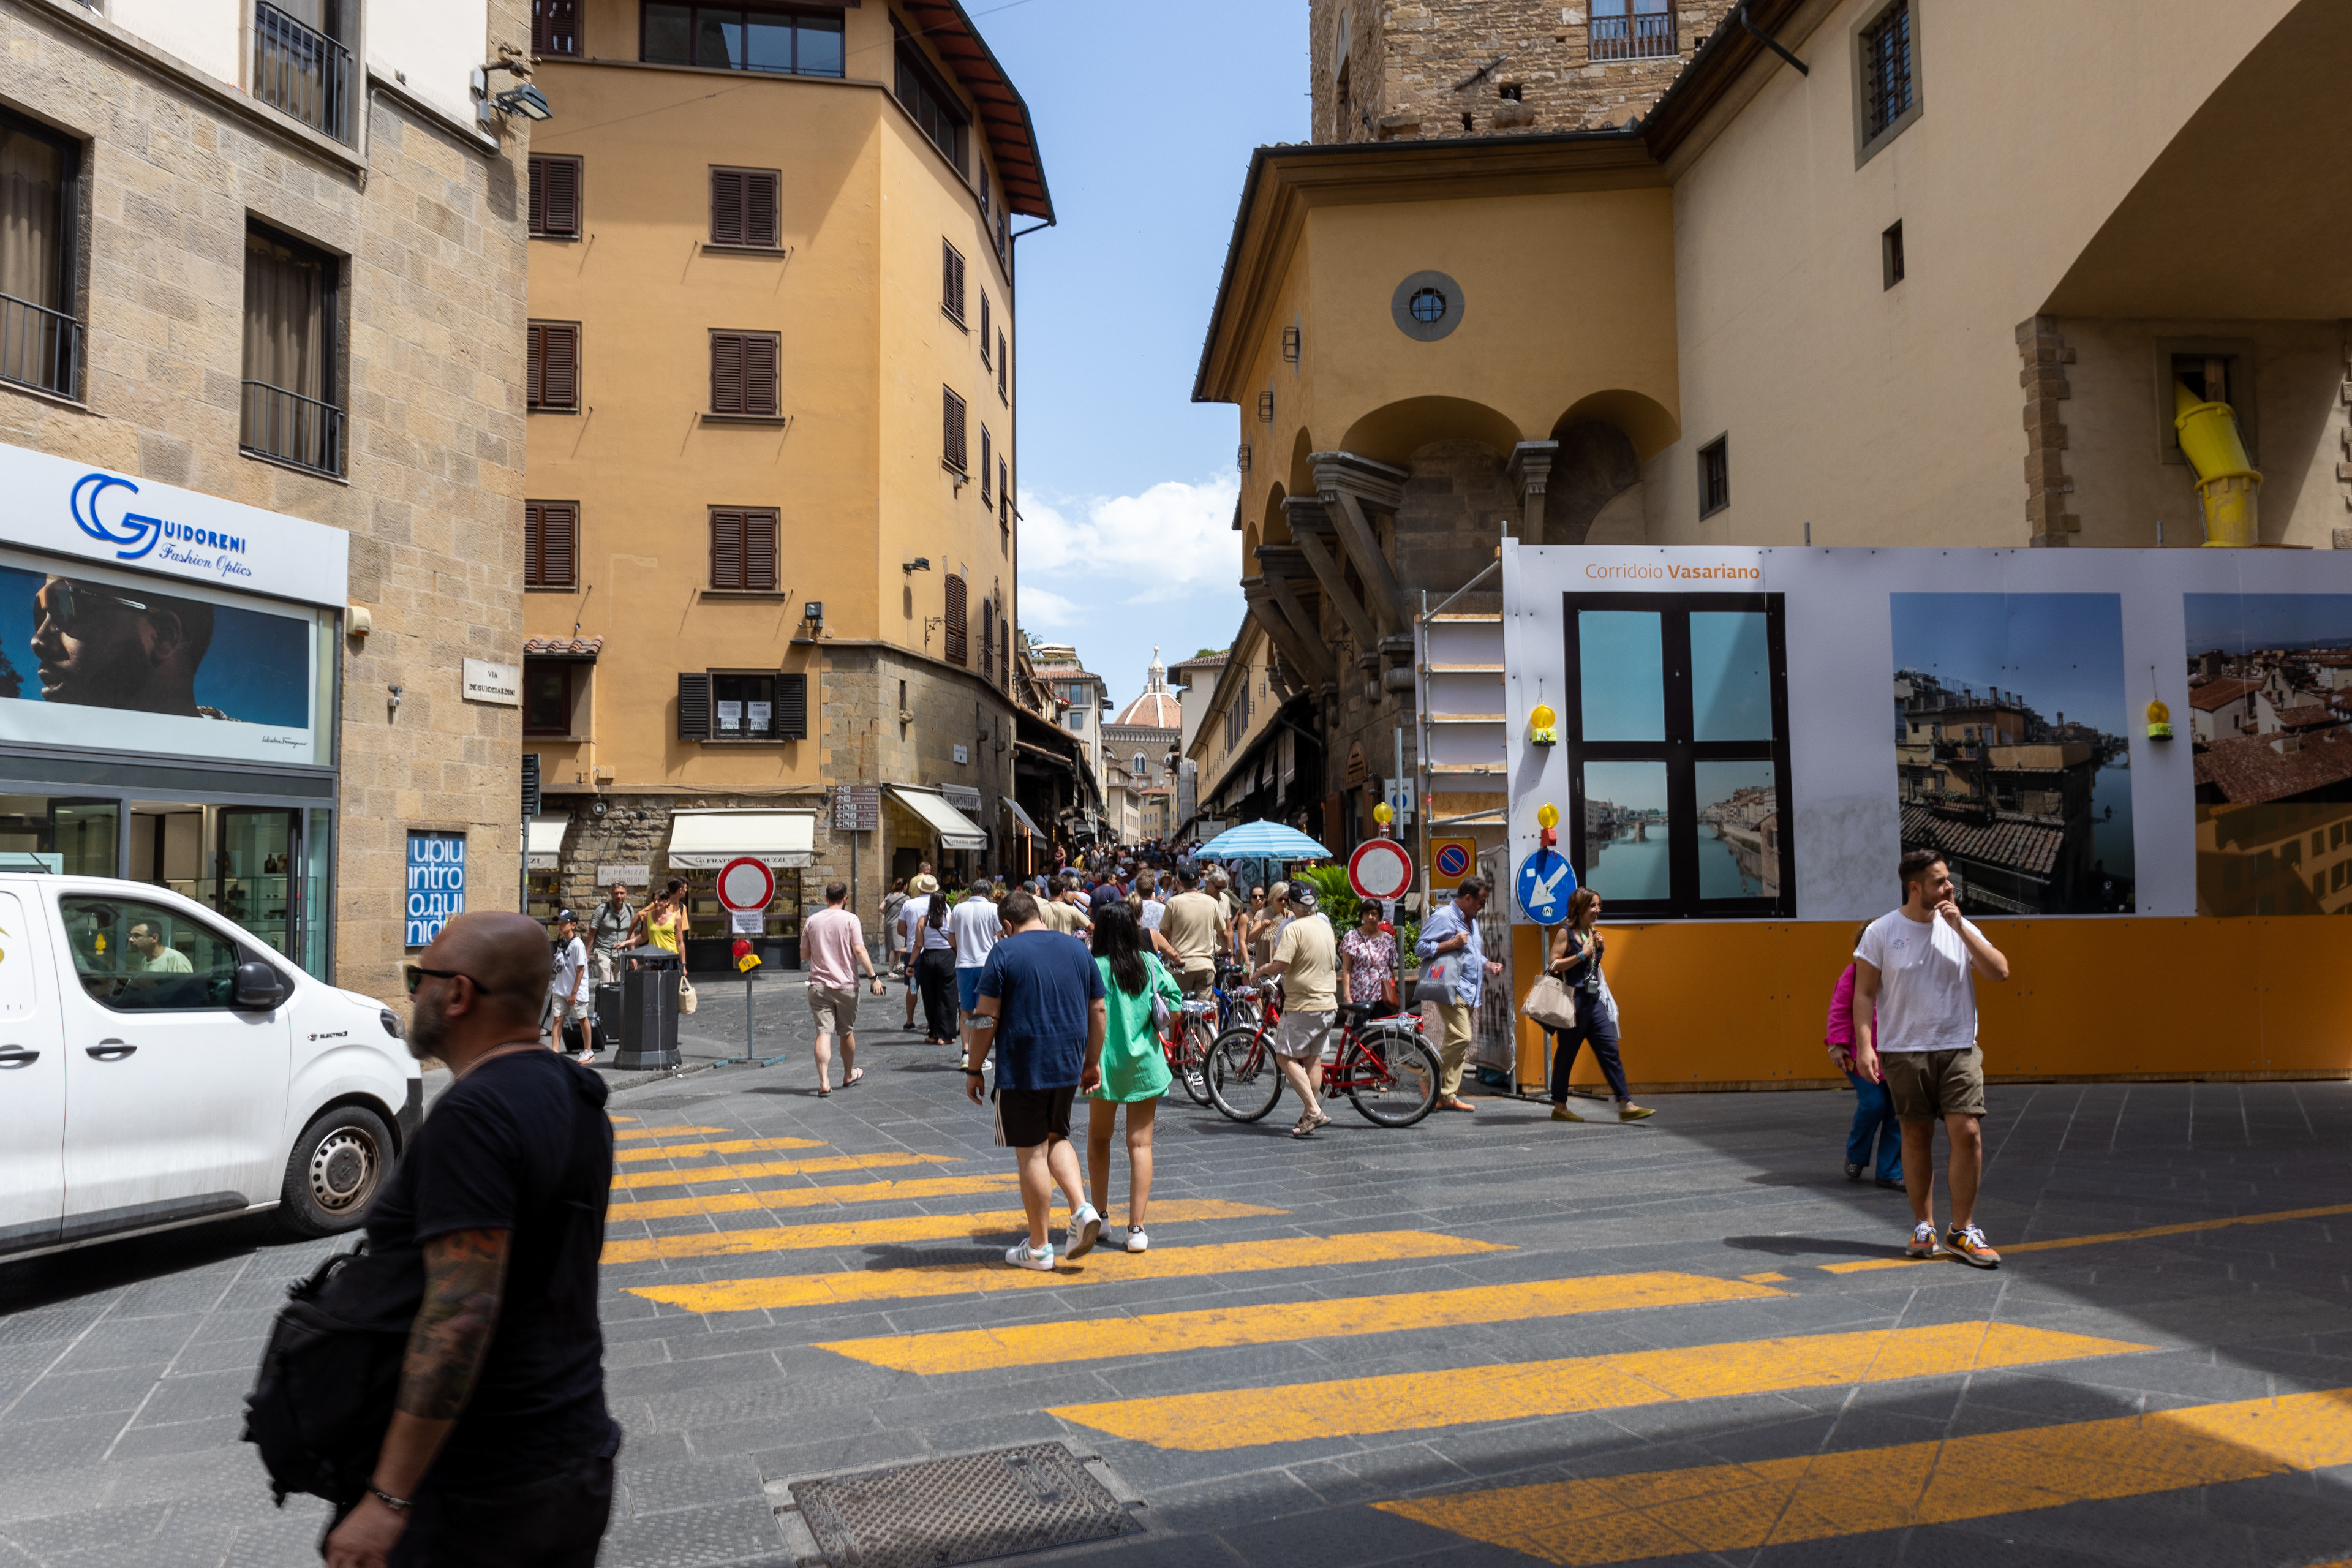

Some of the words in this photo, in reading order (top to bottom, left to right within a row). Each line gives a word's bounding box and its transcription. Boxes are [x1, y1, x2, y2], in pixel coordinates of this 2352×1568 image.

[159, 542, 212, 568] Fashion
[216, 554, 252, 577] Optics
[1585, 564, 1663, 579] Corridoio
[1667, 563, 1760, 579] Vasariano
[488, 670, 498, 679] VIA
